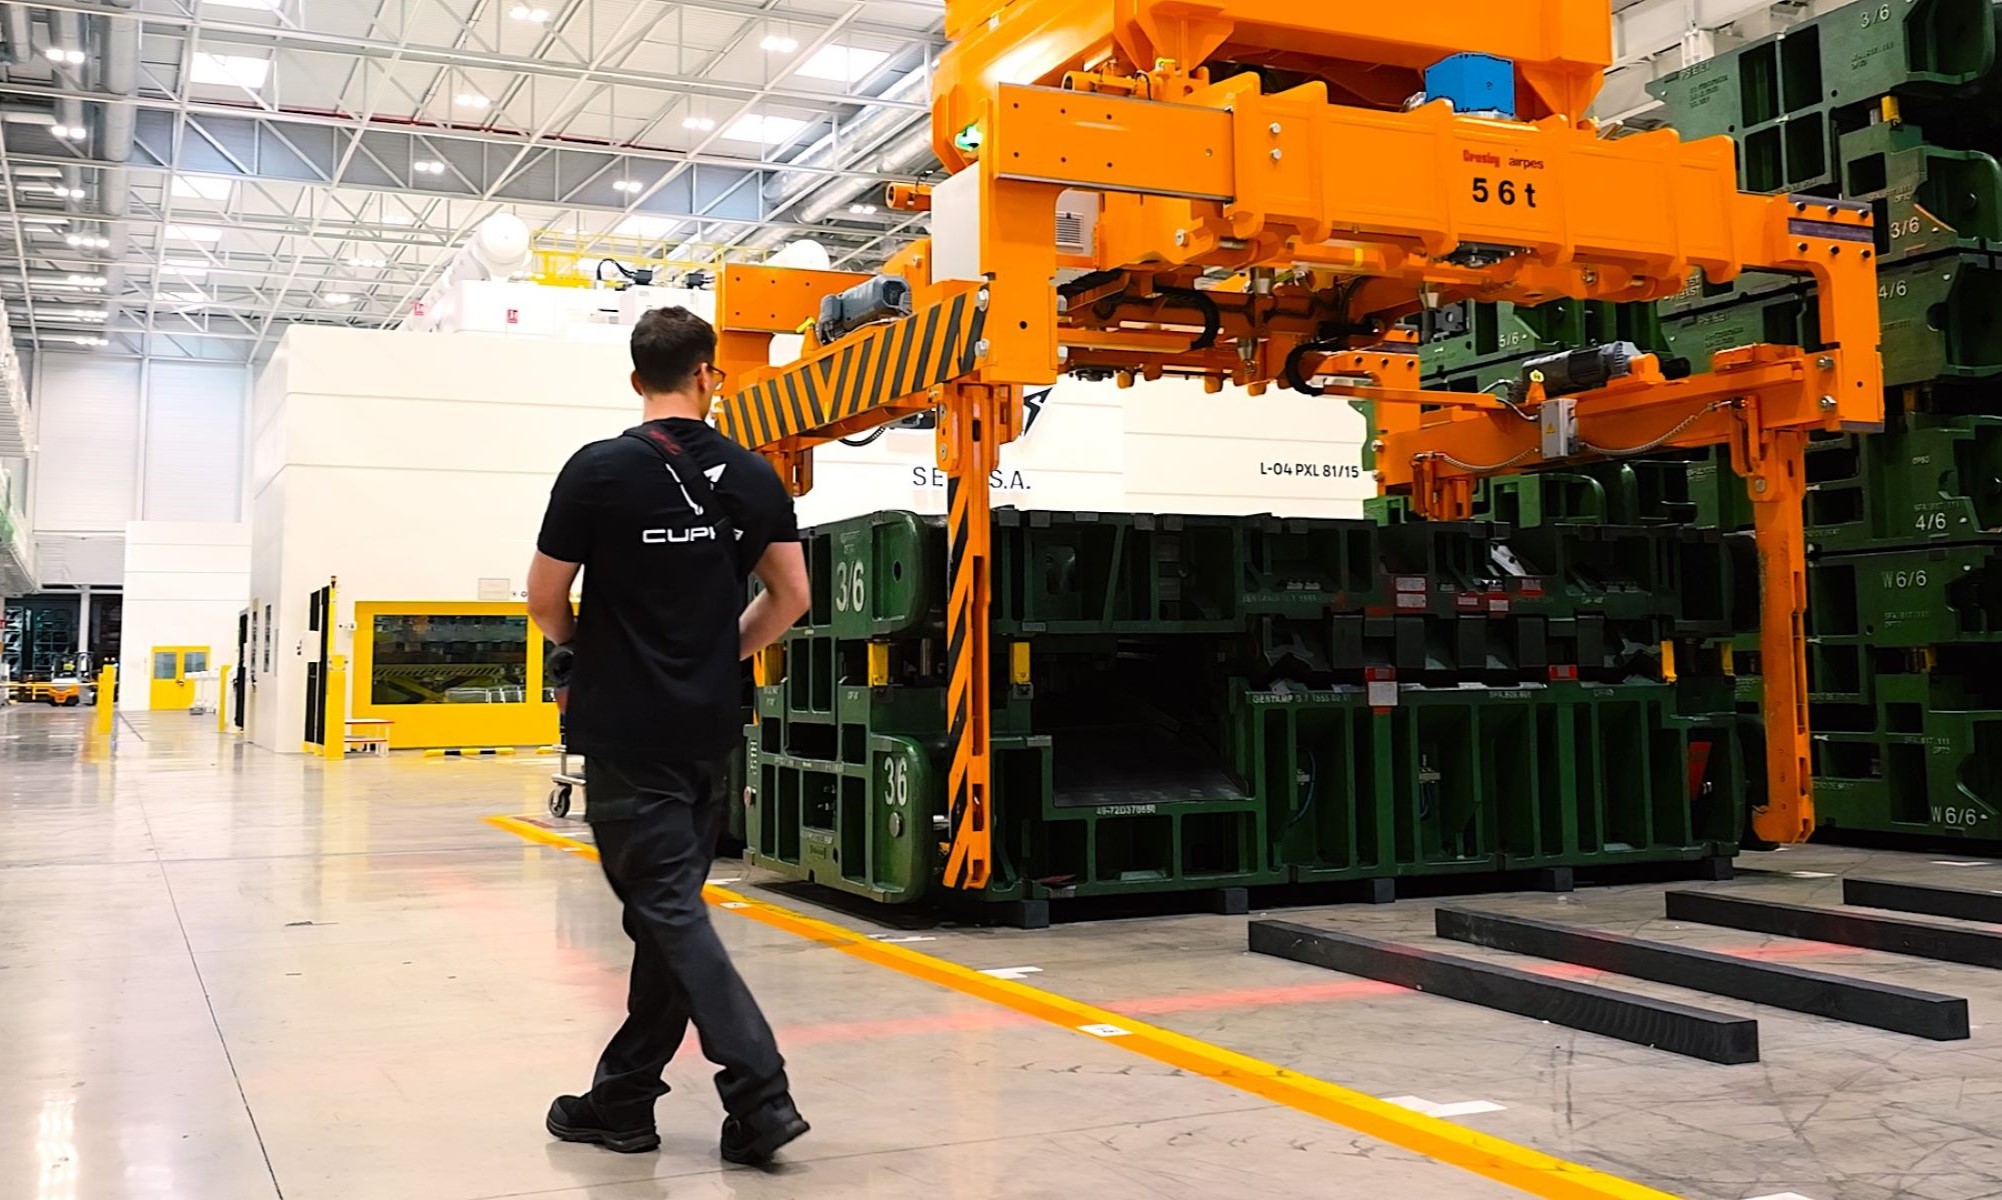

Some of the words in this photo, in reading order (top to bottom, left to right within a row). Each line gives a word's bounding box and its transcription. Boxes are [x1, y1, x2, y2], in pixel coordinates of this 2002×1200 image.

[1860, 3, 1890, 28] 3/6
[1890, 216, 1920, 239] 3/6
[1878, 280, 1907, 299] 4/6
[1500, 331, 1519, 348] 5/6
[989, 469, 1031, 490] S.A.
[1260, 462, 1292, 476] L-04
[1295, 463, 1320, 477] PXL
[1323, 464, 1360, 478] 81/15
[1915, 512, 1947, 531] 4/6
[836, 560, 865, 612] 3/6
